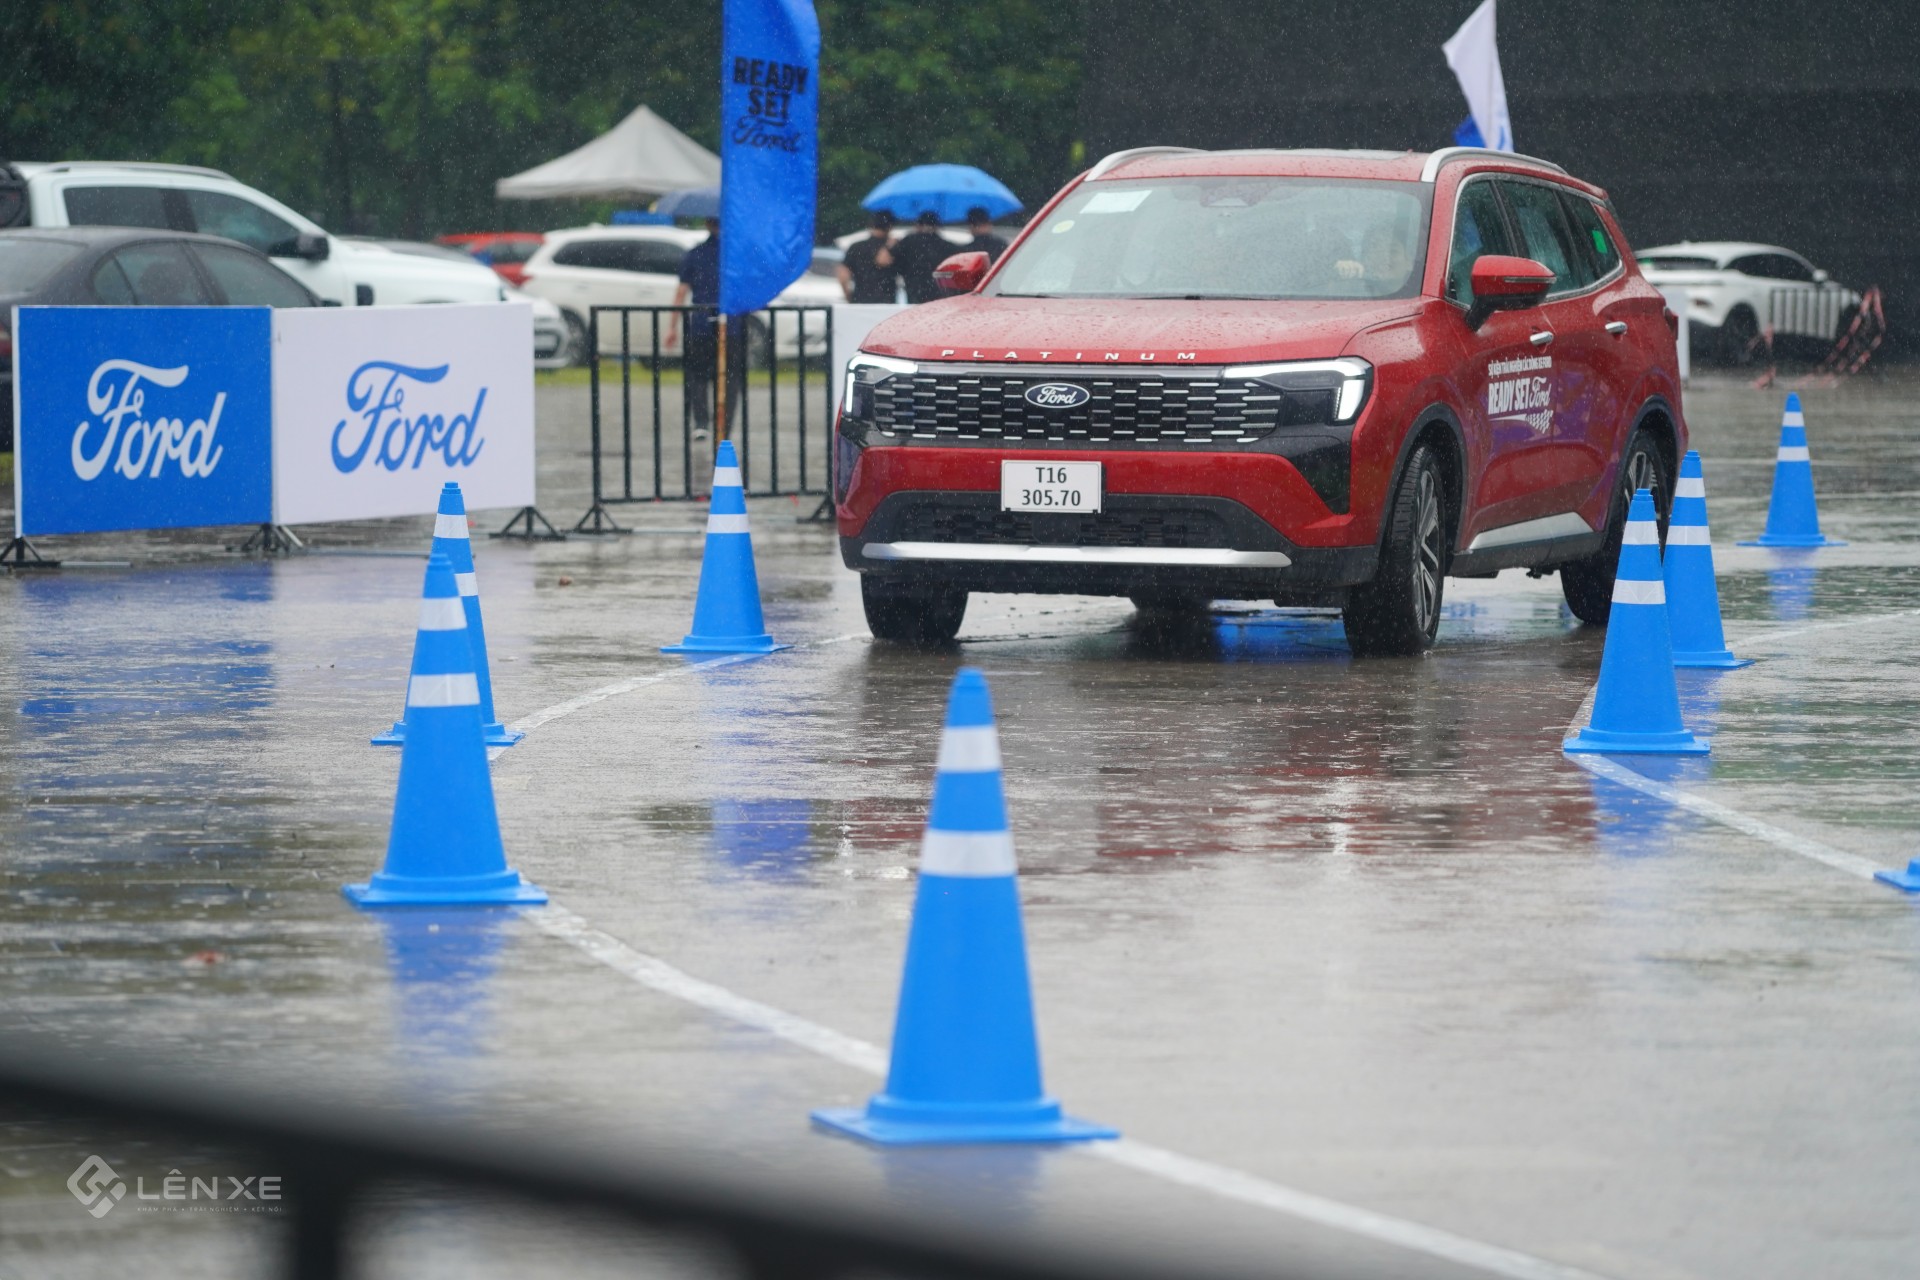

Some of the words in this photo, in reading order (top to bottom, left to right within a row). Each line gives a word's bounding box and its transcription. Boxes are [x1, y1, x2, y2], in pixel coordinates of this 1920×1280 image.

[733, 56, 808, 94] READY
[748, 89, 791, 119] SET
[733, 115, 800, 152] Ford
[941, 349, 1197, 361] PLATINUM
[1036, 386, 1077, 405] Ford
[1488, 381, 1515, 415] READY
[1515, 377, 1530, 411] SET
[1529, 376, 1552, 408] Ford
[71, 358, 226, 482] Ford
[331, 359, 488, 474] Ford
[1035, 467, 1067, 484] T16
[1021, 489, 1081, 506] 305.70
